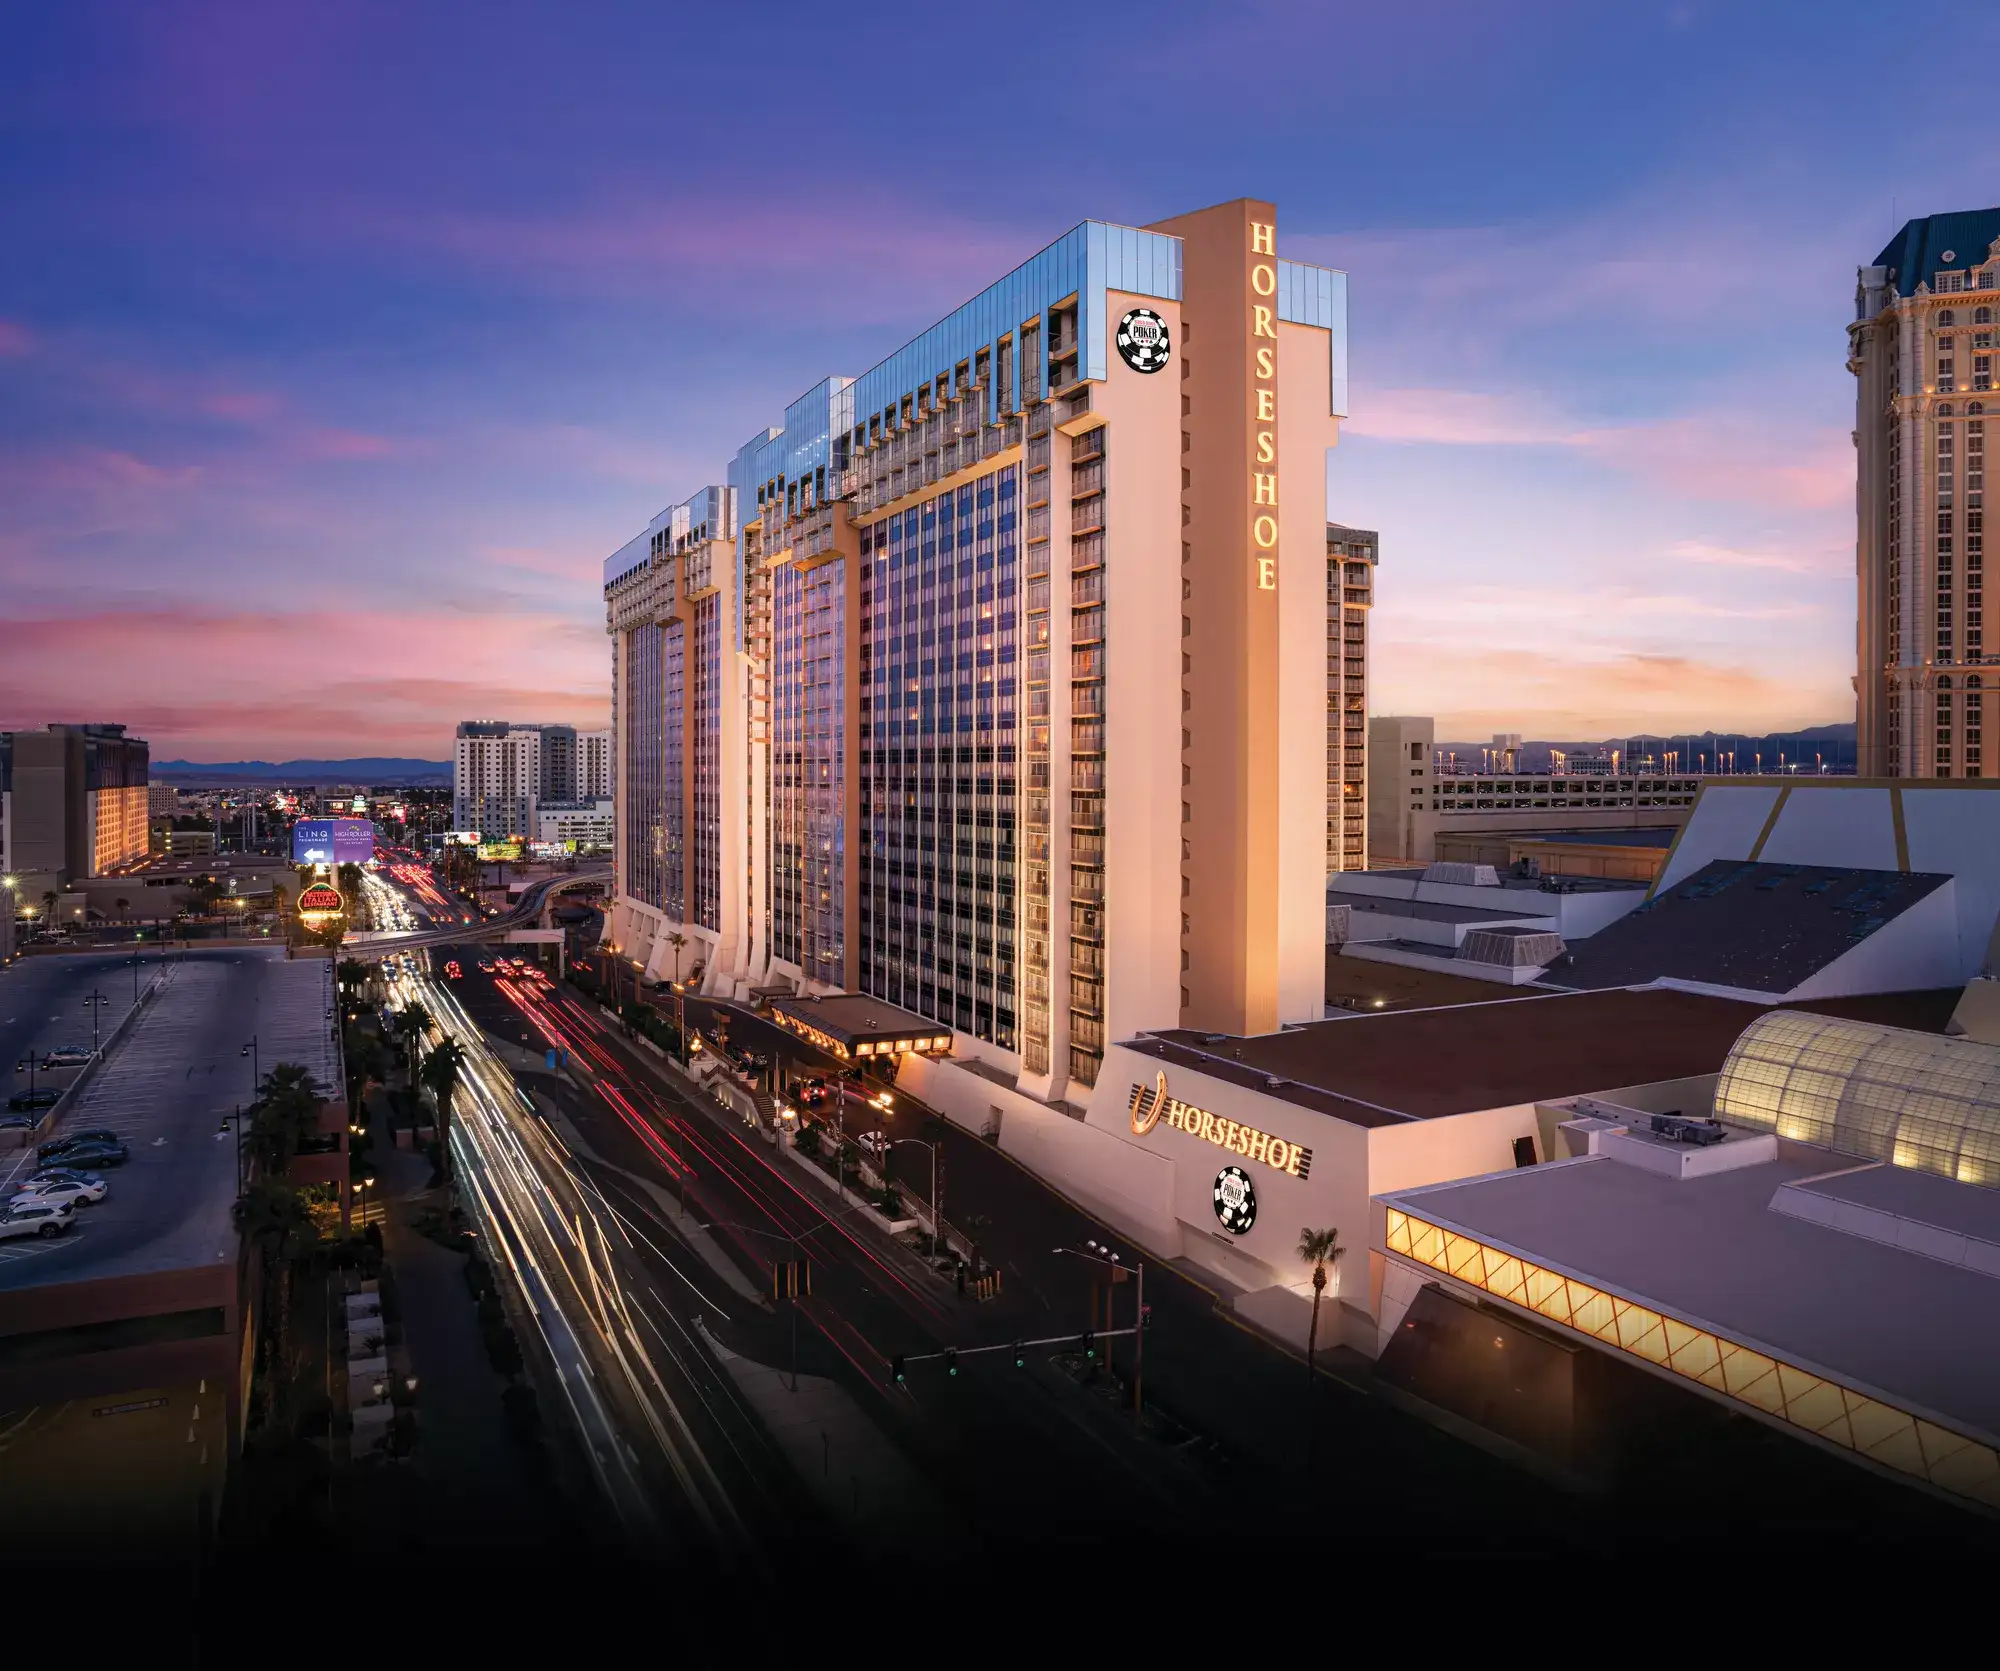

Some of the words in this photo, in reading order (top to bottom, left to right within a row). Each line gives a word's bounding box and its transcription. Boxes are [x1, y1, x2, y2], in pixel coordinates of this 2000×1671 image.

[1133, 326, 1157, 339] POKER
[1250, 222, 1278, 590] HORSESHOE
[298, 830, 328, 838] LINQ
[350, 830, 371, 838] ROLLER
[1167, 1099, 1303, 1176] HORSESHOE
[1223, 1183, 1242, 1201] POKER
